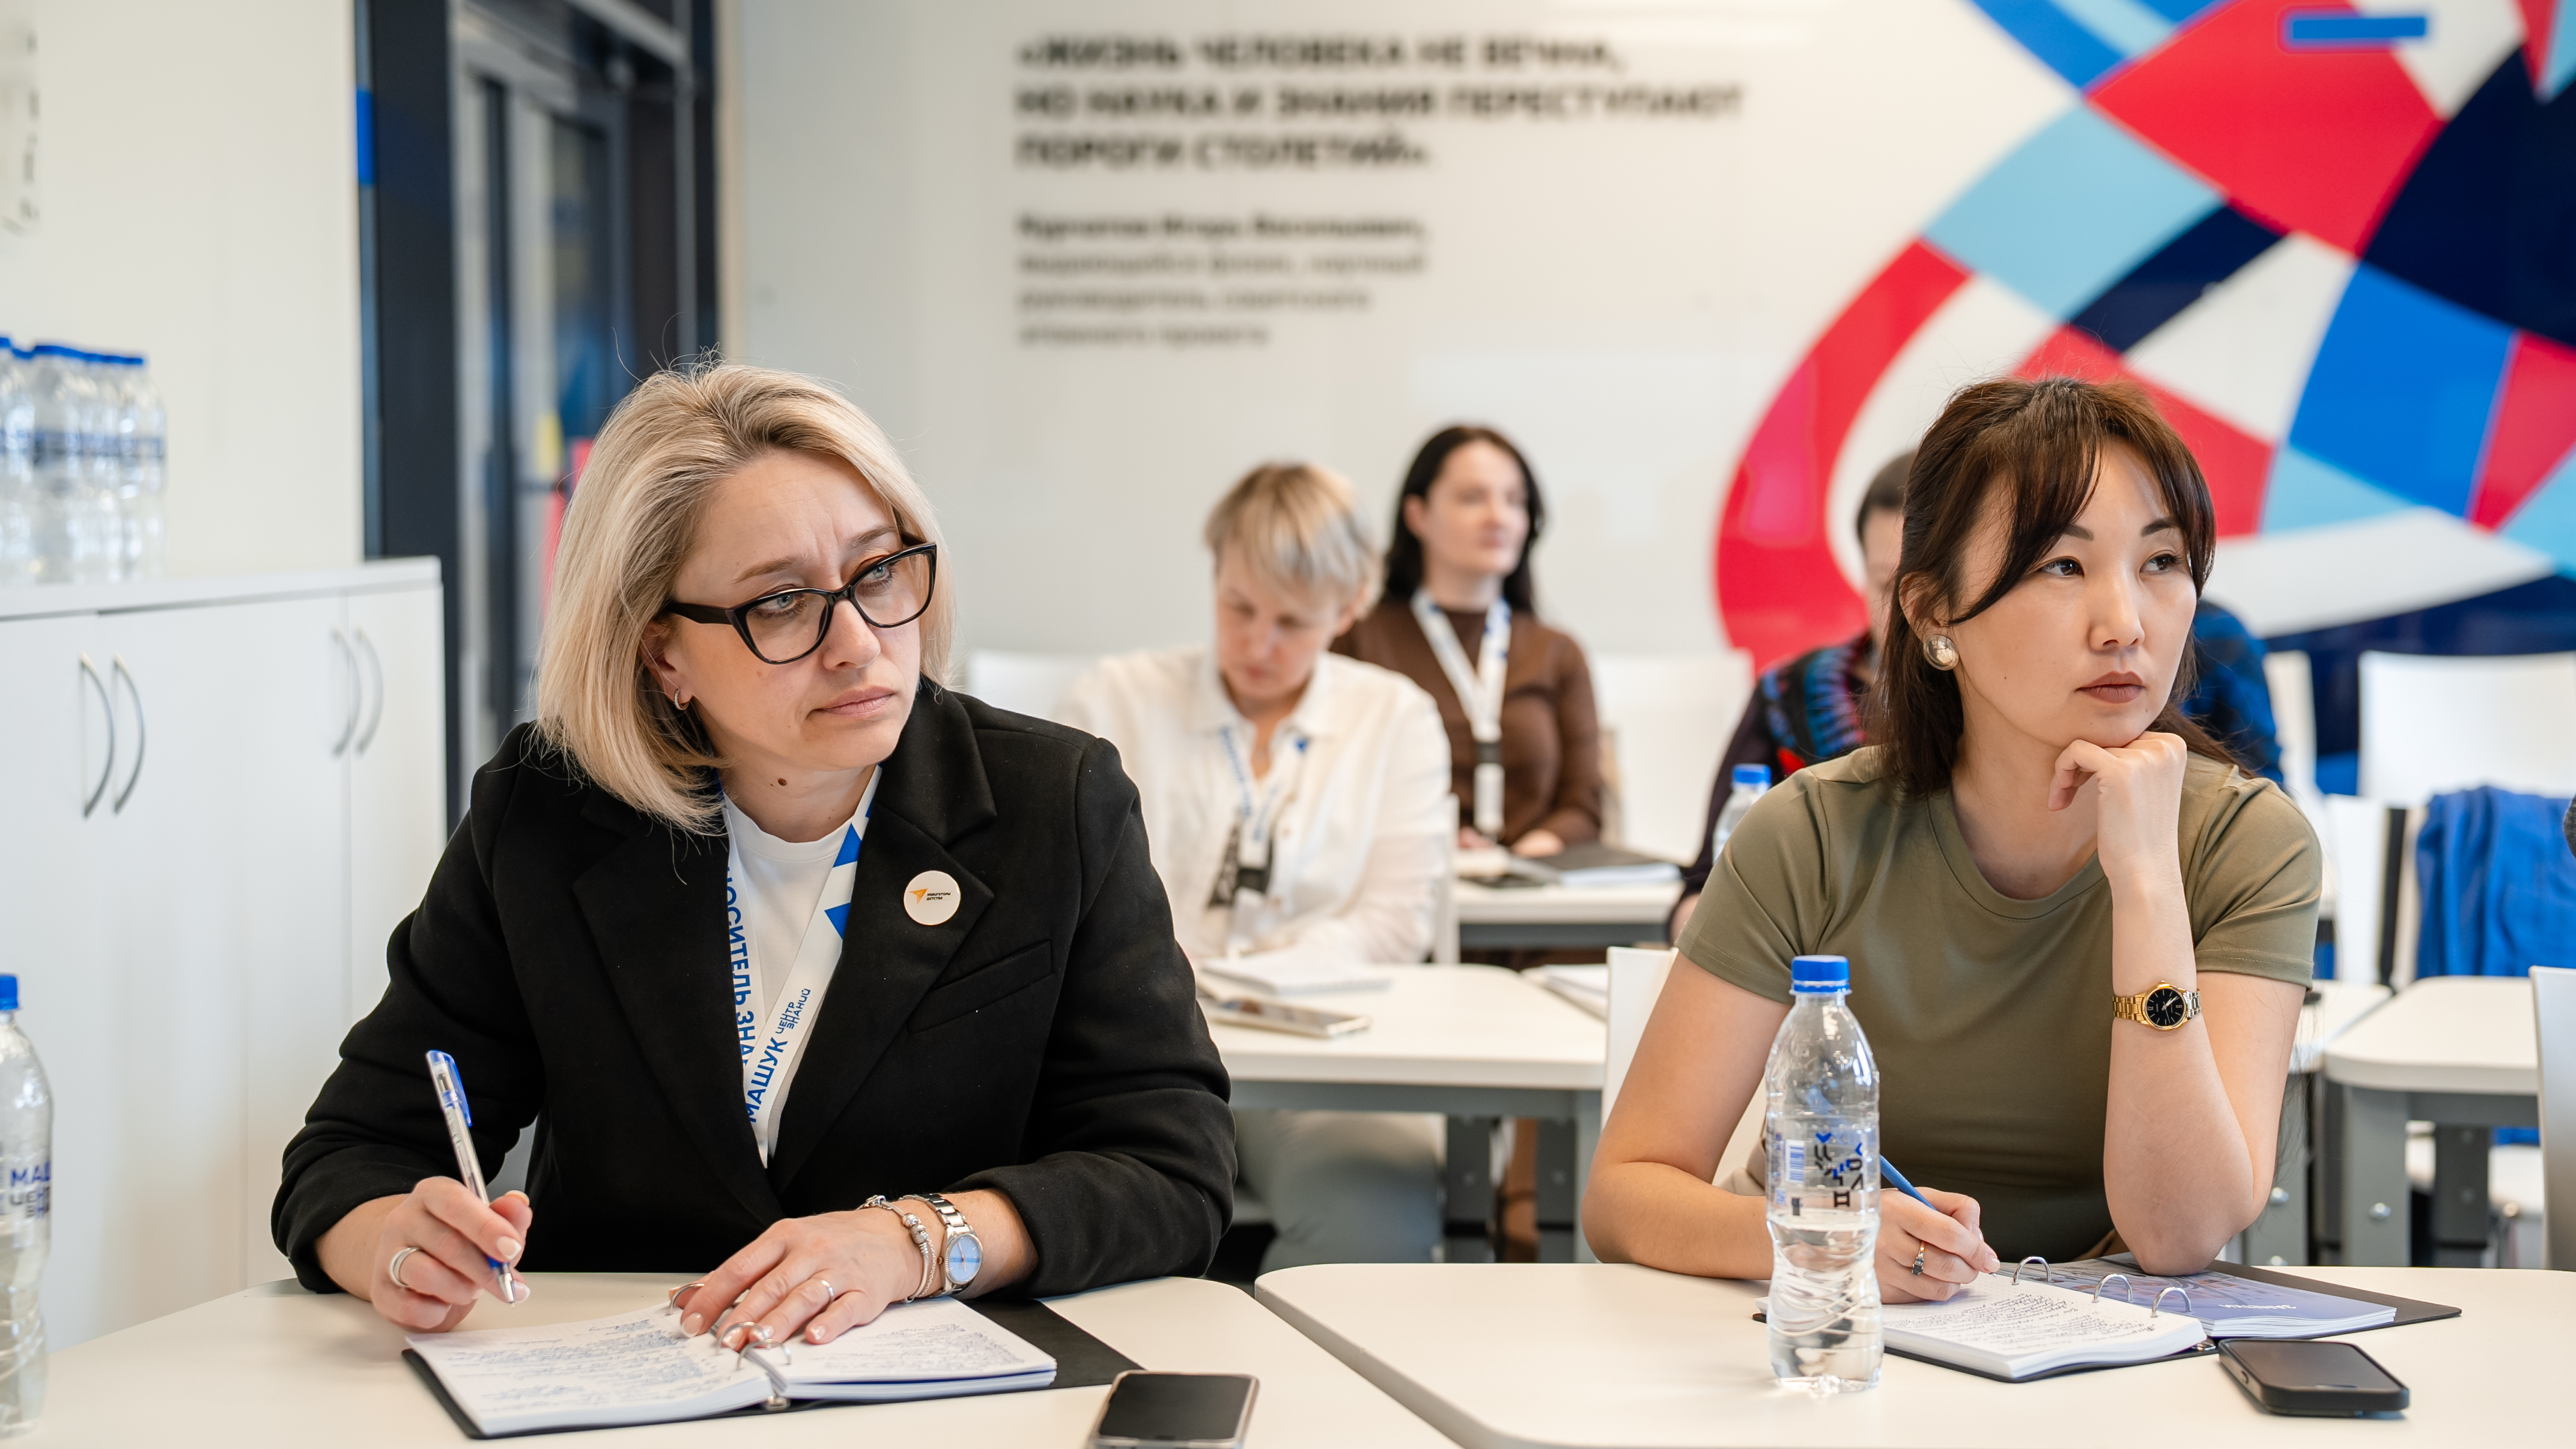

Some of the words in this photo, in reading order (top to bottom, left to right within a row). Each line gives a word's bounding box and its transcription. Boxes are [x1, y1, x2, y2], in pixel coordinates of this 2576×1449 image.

[1192, 34, 1411, 71] ЧЕЛОВЕКА
[1416, 34, 1472, 71] НЕ
[1014, 84, 1078, 121] НО
[1086, 84, 1226, 121] НАУКА
[1229, 84, 1264, 121] И
[1269, 84, 1439, 121] ЗНАНИЯ
[1446, 84, 1749, 121] ПЕРЕСТУПАЮТ
[1015, 133, 1186, 171] ПОРОГИ
[727, 866, 752, 1006] ОСИТЕЛЬ
[775, 1001, 795, 1034] ЦЕНТР
[786, 988, 812, 1030] ЗНАНИЙ
[736, 1010, 756, 1067] ЗНА
[746, 1036, 789, 1123] МАШУК
